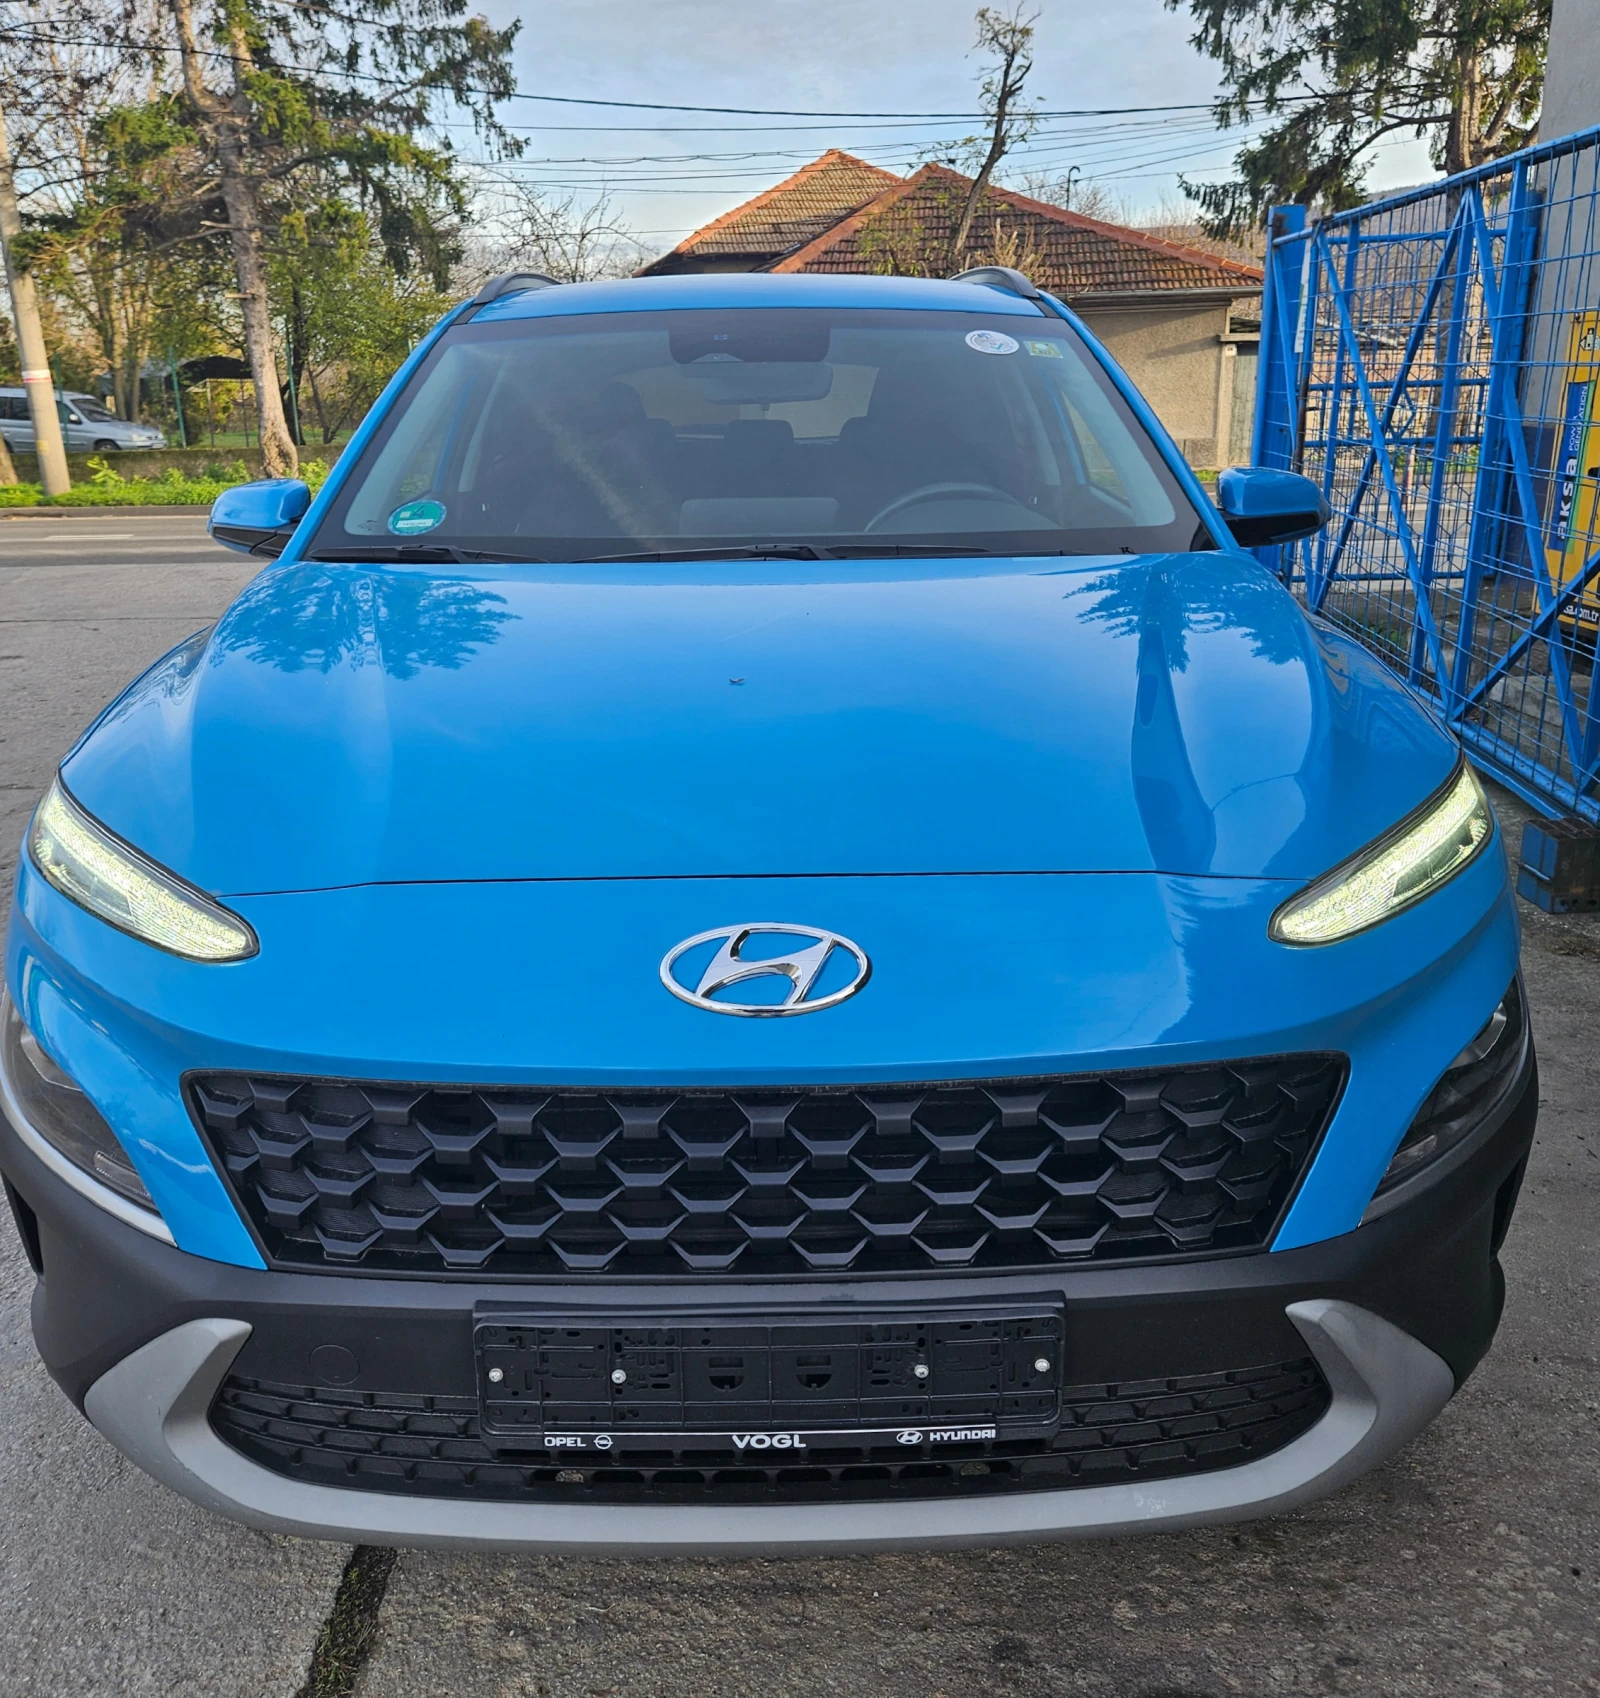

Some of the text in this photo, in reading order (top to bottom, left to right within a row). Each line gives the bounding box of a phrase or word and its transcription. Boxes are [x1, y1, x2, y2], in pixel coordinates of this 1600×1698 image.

[1573, 386, 1588, 451] GENEATION
[1557, 458, 1577, 540] aksa
[411, 504, 425, 518] 4
[1563, 605, 1599, 622] sa.com.tr
[544, 1437, 587, 1447] OPEL
[731, 1434, 807, 1449] VOGL
[929, 1429, 996, 1441] HYUNDAI
